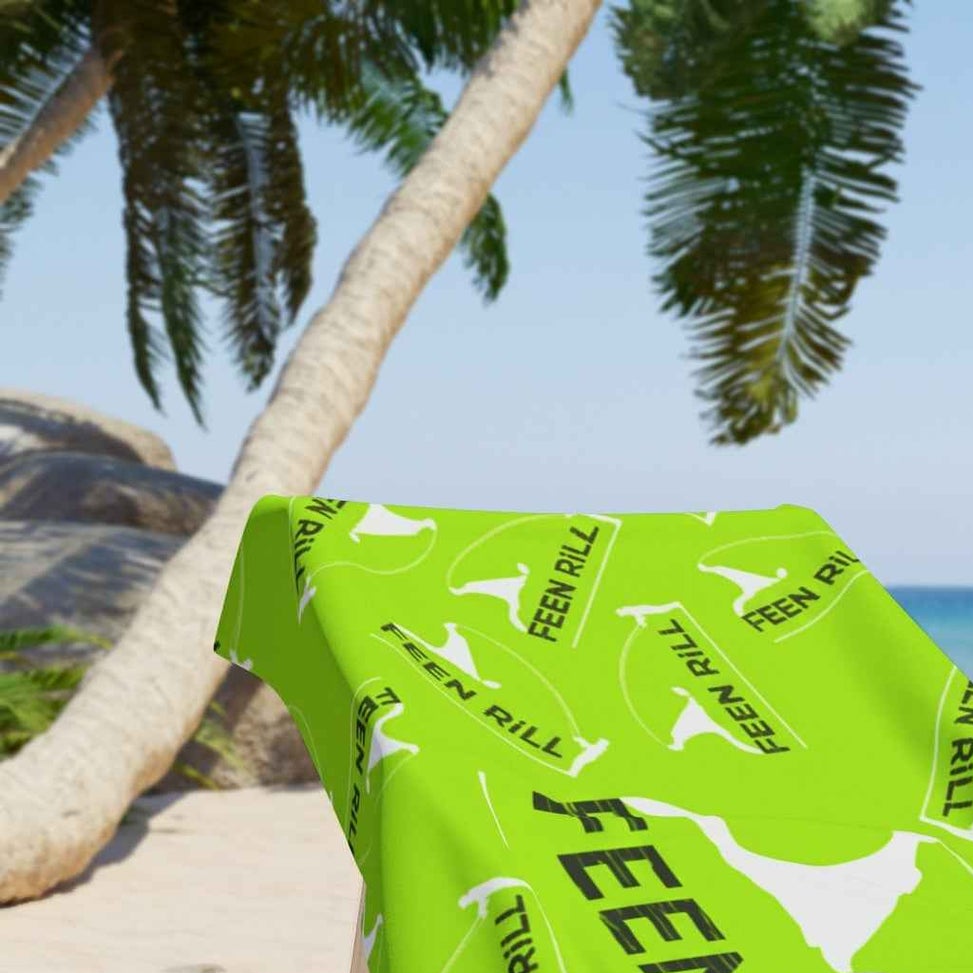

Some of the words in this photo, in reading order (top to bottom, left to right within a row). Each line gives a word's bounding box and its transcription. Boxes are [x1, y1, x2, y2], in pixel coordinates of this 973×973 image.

[528, 579, 577, 643] FEEN
[741, 586, 821, 633] FEEN
[380, 621, 477, 700] FEEN
[708, 683, 791, 755] FEEN
